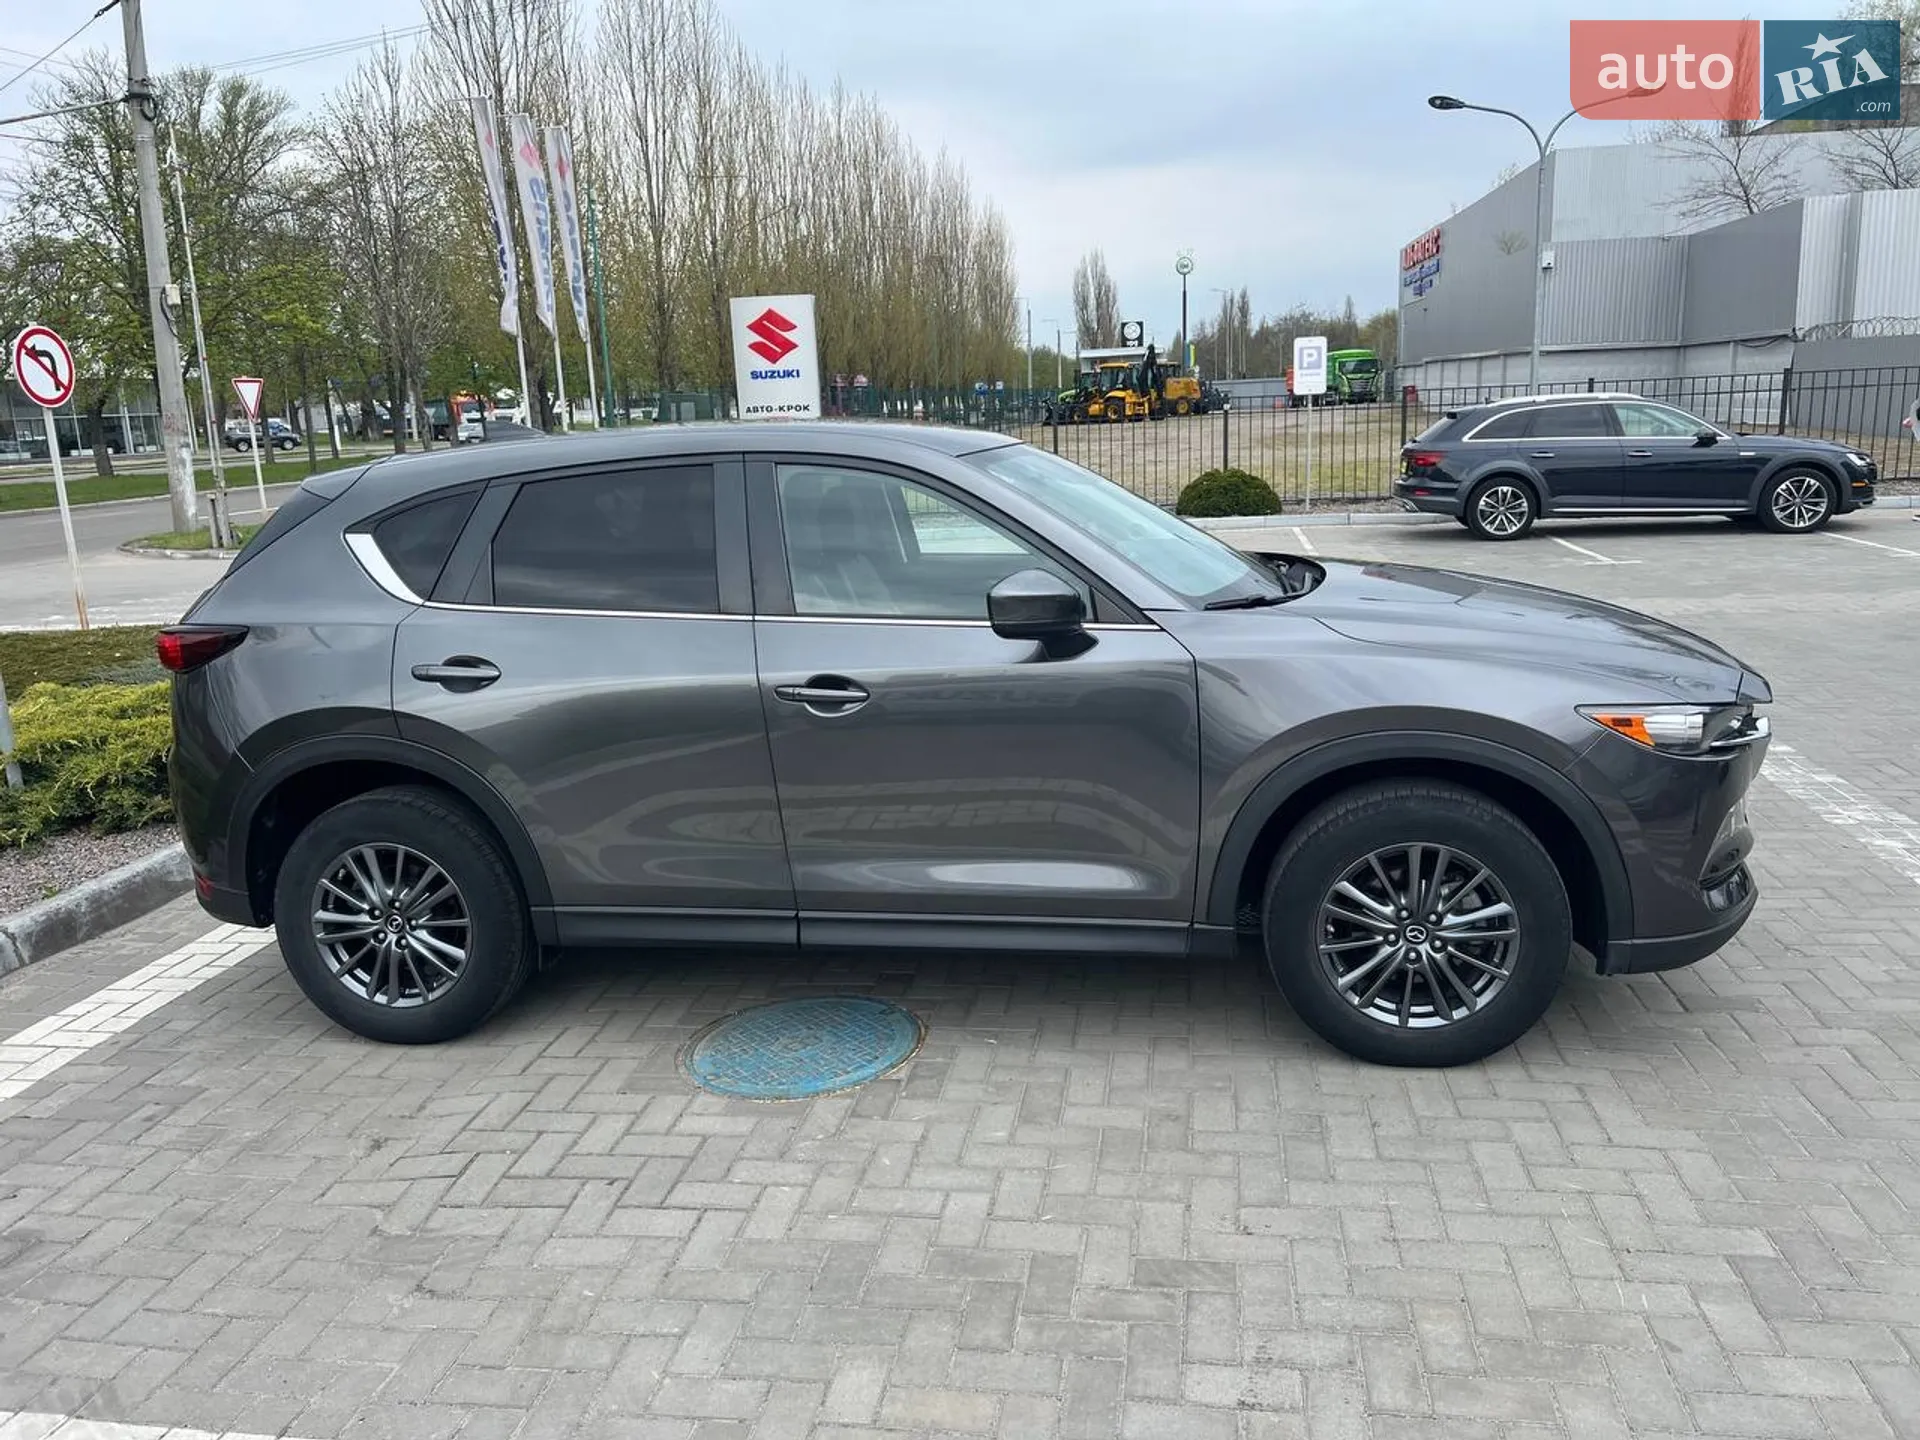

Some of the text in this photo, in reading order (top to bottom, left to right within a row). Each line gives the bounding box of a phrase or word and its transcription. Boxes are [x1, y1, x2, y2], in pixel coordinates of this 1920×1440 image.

[1303, 348, 1318, 368] P
[750, 368, 800, 380] SUZUKI
[745, 404, 810, 414] АВТО-КРОК
